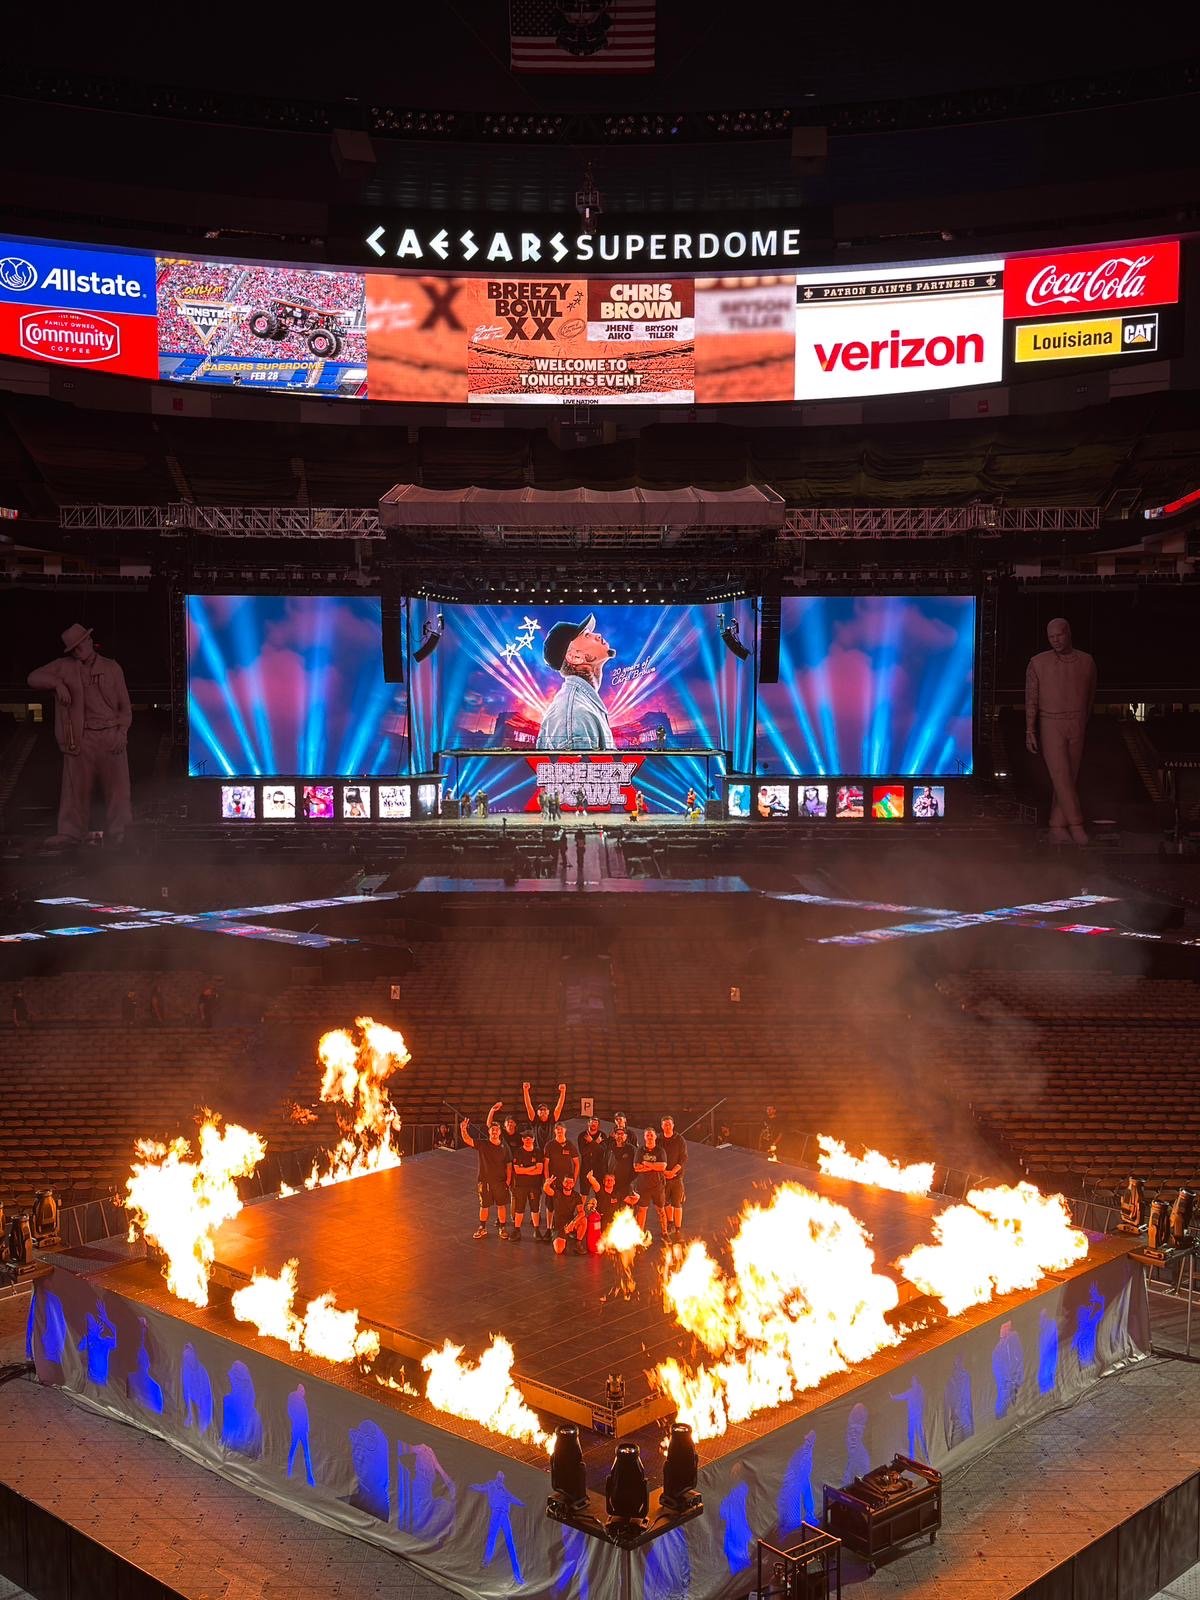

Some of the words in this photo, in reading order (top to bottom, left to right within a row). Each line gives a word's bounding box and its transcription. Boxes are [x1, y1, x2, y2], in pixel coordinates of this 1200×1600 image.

[366, 226, 568, 262] CAESARS
[576, 229, 800, 260] SUPERDOME
[40, 268, 141, 297] Allstate
[823, 287, 867, 297] PATRON
[870, 284, 912, 294] SAINTS
[916, 279, 976, 291] PARTNERS
[1025, 256, 1154, 307] Coca-Cola
[487, 282, 572, 300] BREEZY
[609, 284, 673, 301] CHRIS
[177, 305, 233, 319] MONSTER
[495, 299, 563, 317] BOWL
[600, 301, 682, 319] BROWN
[44, 319, 68, 327] FAMILY
[70, 321, 95, 330] OWNED
[193, 316, 219, 326] JAM
[504, 316, 556, 340] XX
[25, 322, 114, 351] Community
[607, 332, 632, 340] AIKO
[1033, 331, 1113, 350] Louisiana
[1124, 323, 1154, 344] CAT
[51, 345, 91, 355] COFFEE
[814, 329, 985, 372] verizon
[203, 362, 253, 372] CAESARS
[256, 361, 325, 371] SUPERDOME
[534, 359, 605, 371] WELCOME
[607, 359, 628, 371] TO
[250, 372, 266, 381] FEB
[267, 371, 279, 380] 28
[519, 374, 596, 387] TONIGHT'S
[597, 374, 644, 387] EVENT
[536, 762, 637, 785] BREEZY
